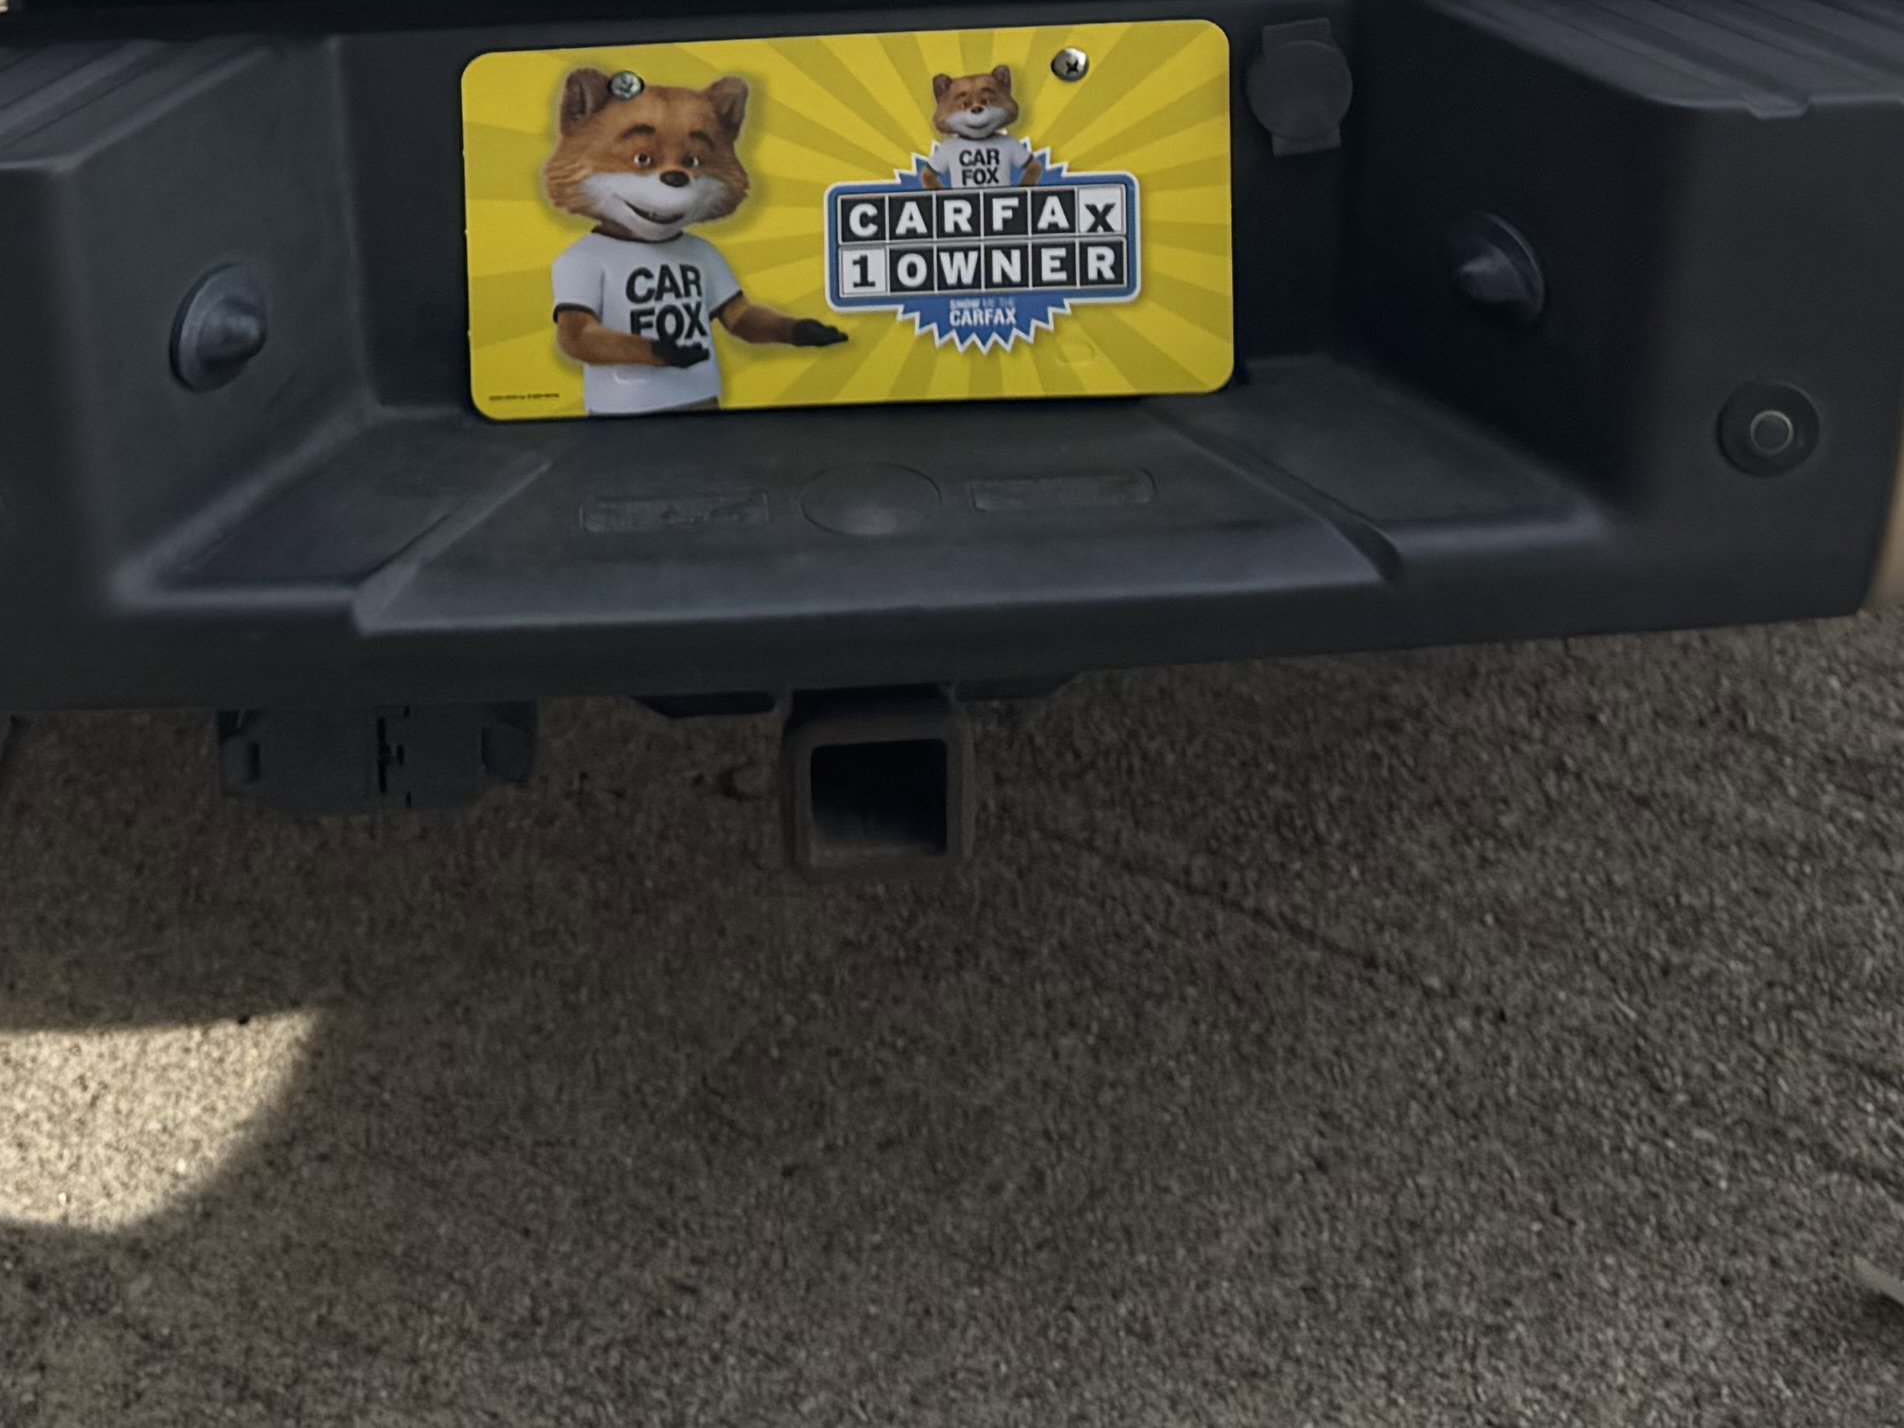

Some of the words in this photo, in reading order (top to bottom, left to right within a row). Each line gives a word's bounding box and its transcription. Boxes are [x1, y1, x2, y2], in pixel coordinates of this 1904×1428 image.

[958, 148, 1000, 167] CAR
[962, 167, 1000, 186] FOX
[849, 194, 1117, 238] CARFAX
[625, 263, 703, 305] CAR
[852, 255, 876, 288] 1
[896, 245, 1117, 288] OWNER
[629, 300, 708, 342] FOX
[949, 306, 1017, 326] CARFAX
